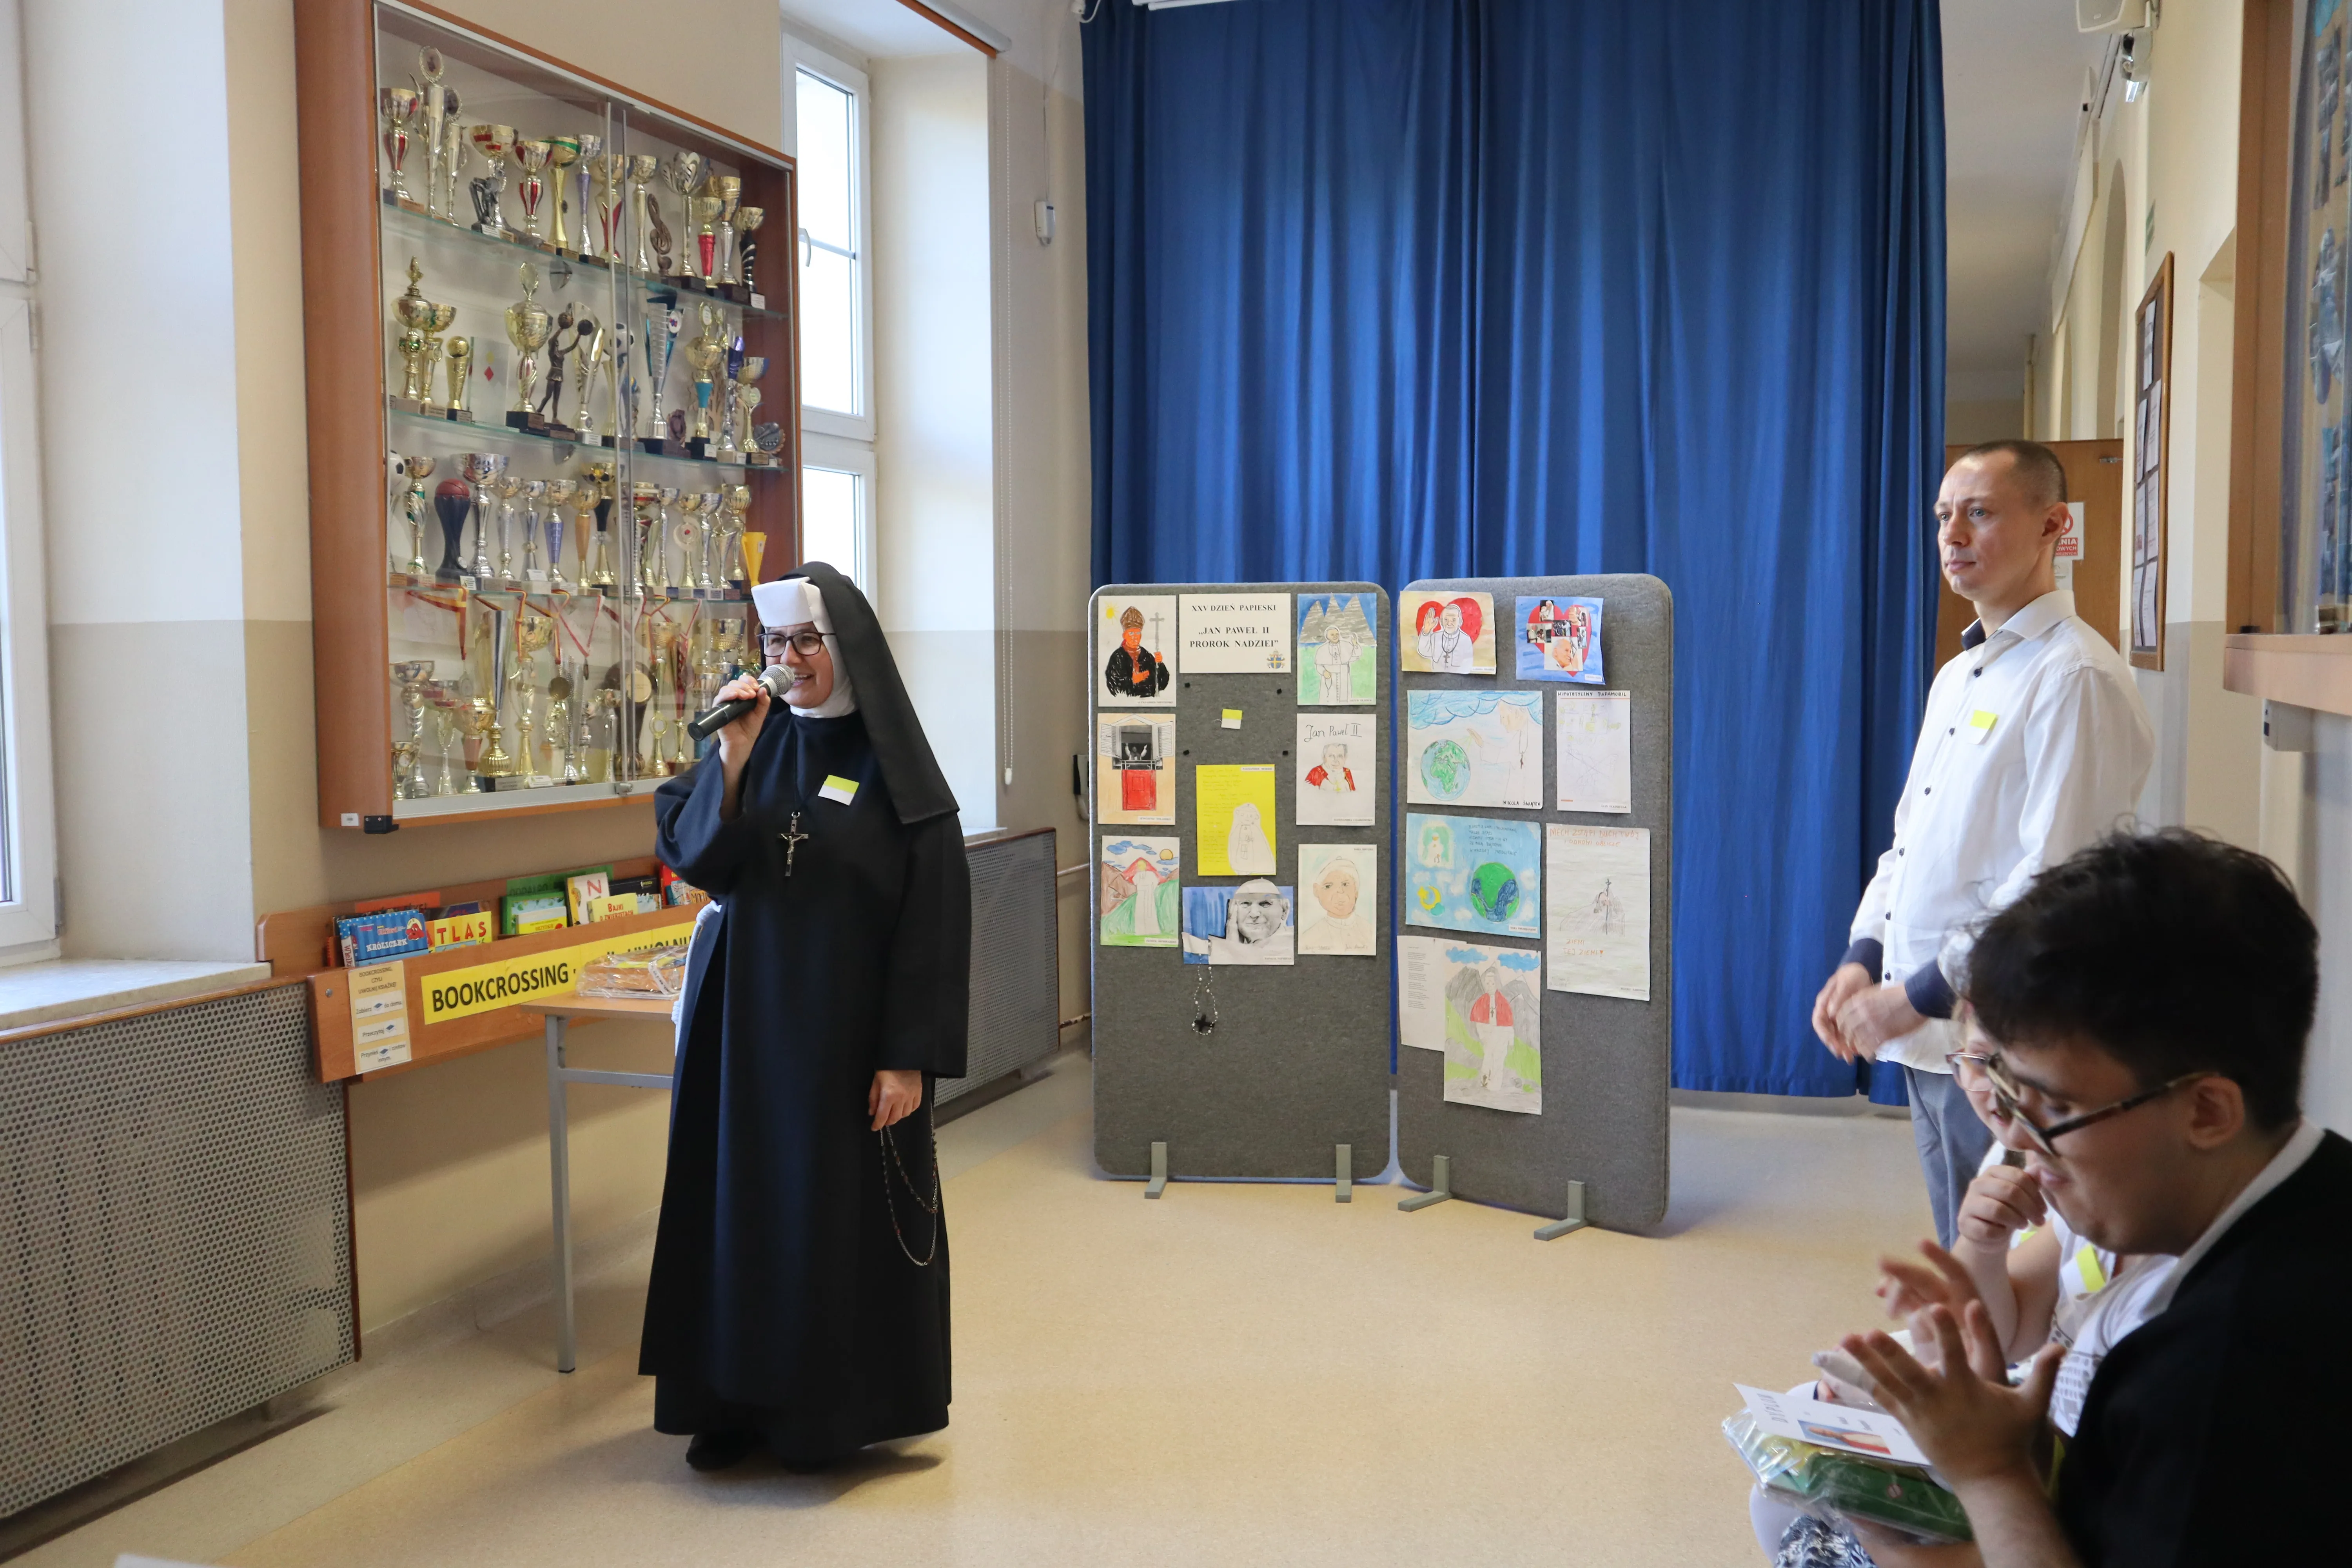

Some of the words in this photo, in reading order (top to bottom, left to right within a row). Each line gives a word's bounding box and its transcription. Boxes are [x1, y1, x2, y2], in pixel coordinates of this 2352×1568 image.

[1198, 627, 1221, 635] „JAN
[1304, 724, 1325, 742] Jan
[1350, 723, 1362, 738] II
[1550, 828, 1569, 837] NIECH
[366, 938, 408, 952] KRÓLICZEK
[358, 985, 378, 994] UWOLNIJ
[432, 963, 568, 1012] BOOKCROSSING
[356, 1006, 372, 1014] Zabierz
[362, 1028, 384, 1038] Przeczytaj
